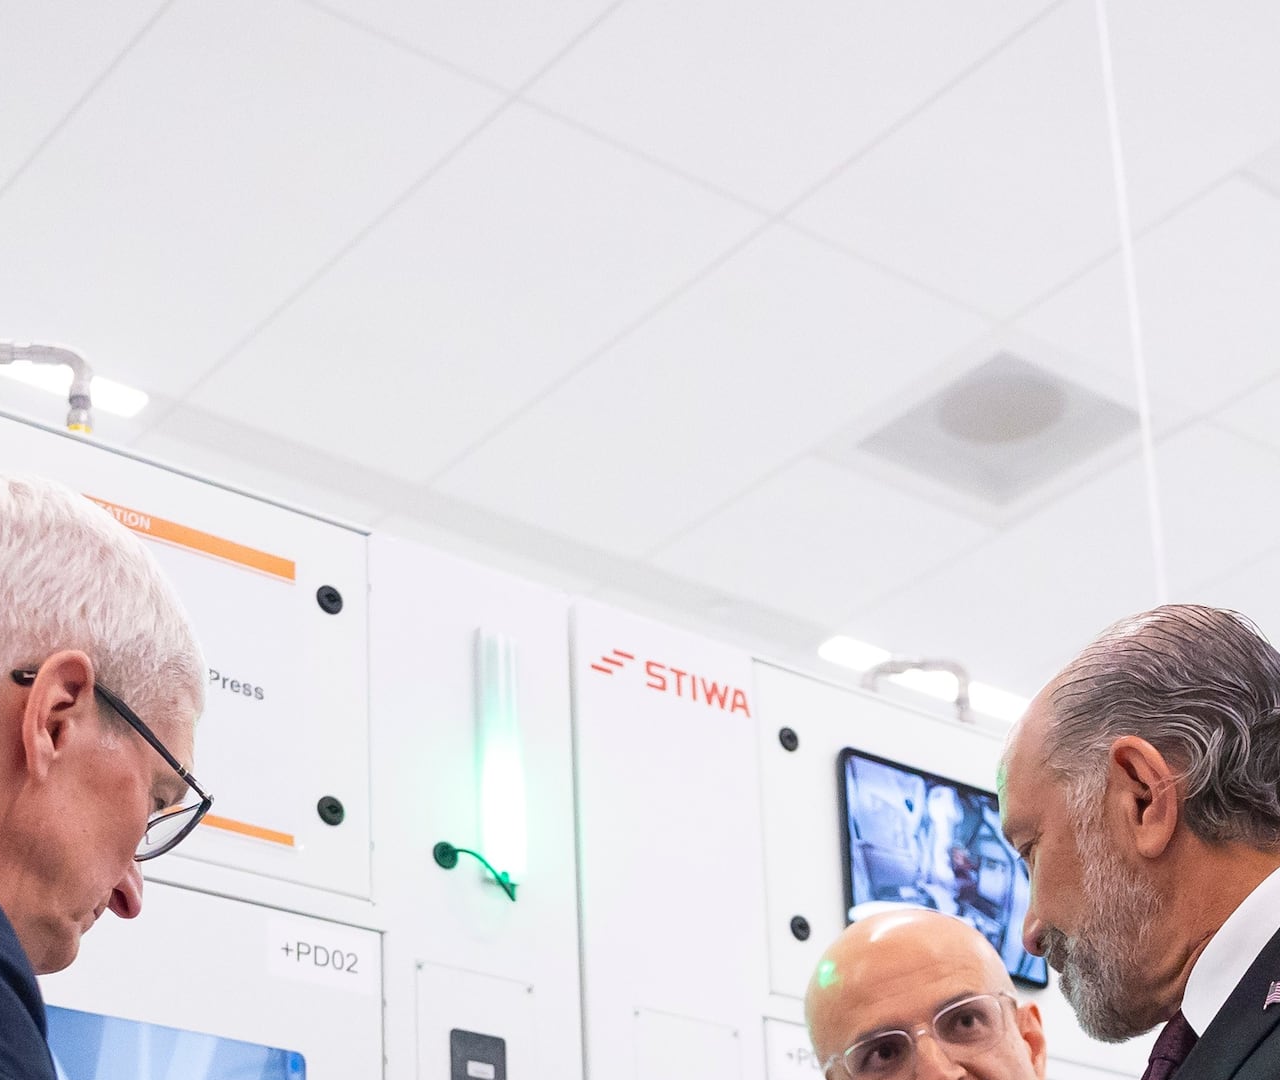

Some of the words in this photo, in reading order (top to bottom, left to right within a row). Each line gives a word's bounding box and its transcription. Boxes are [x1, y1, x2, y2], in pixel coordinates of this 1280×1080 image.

[94, 501, 152, 531] ATION
[208, 668, 265, 701] Press
[645, 660, 751, 719] STIWA
[280, 940, 359, 974] +PD02
